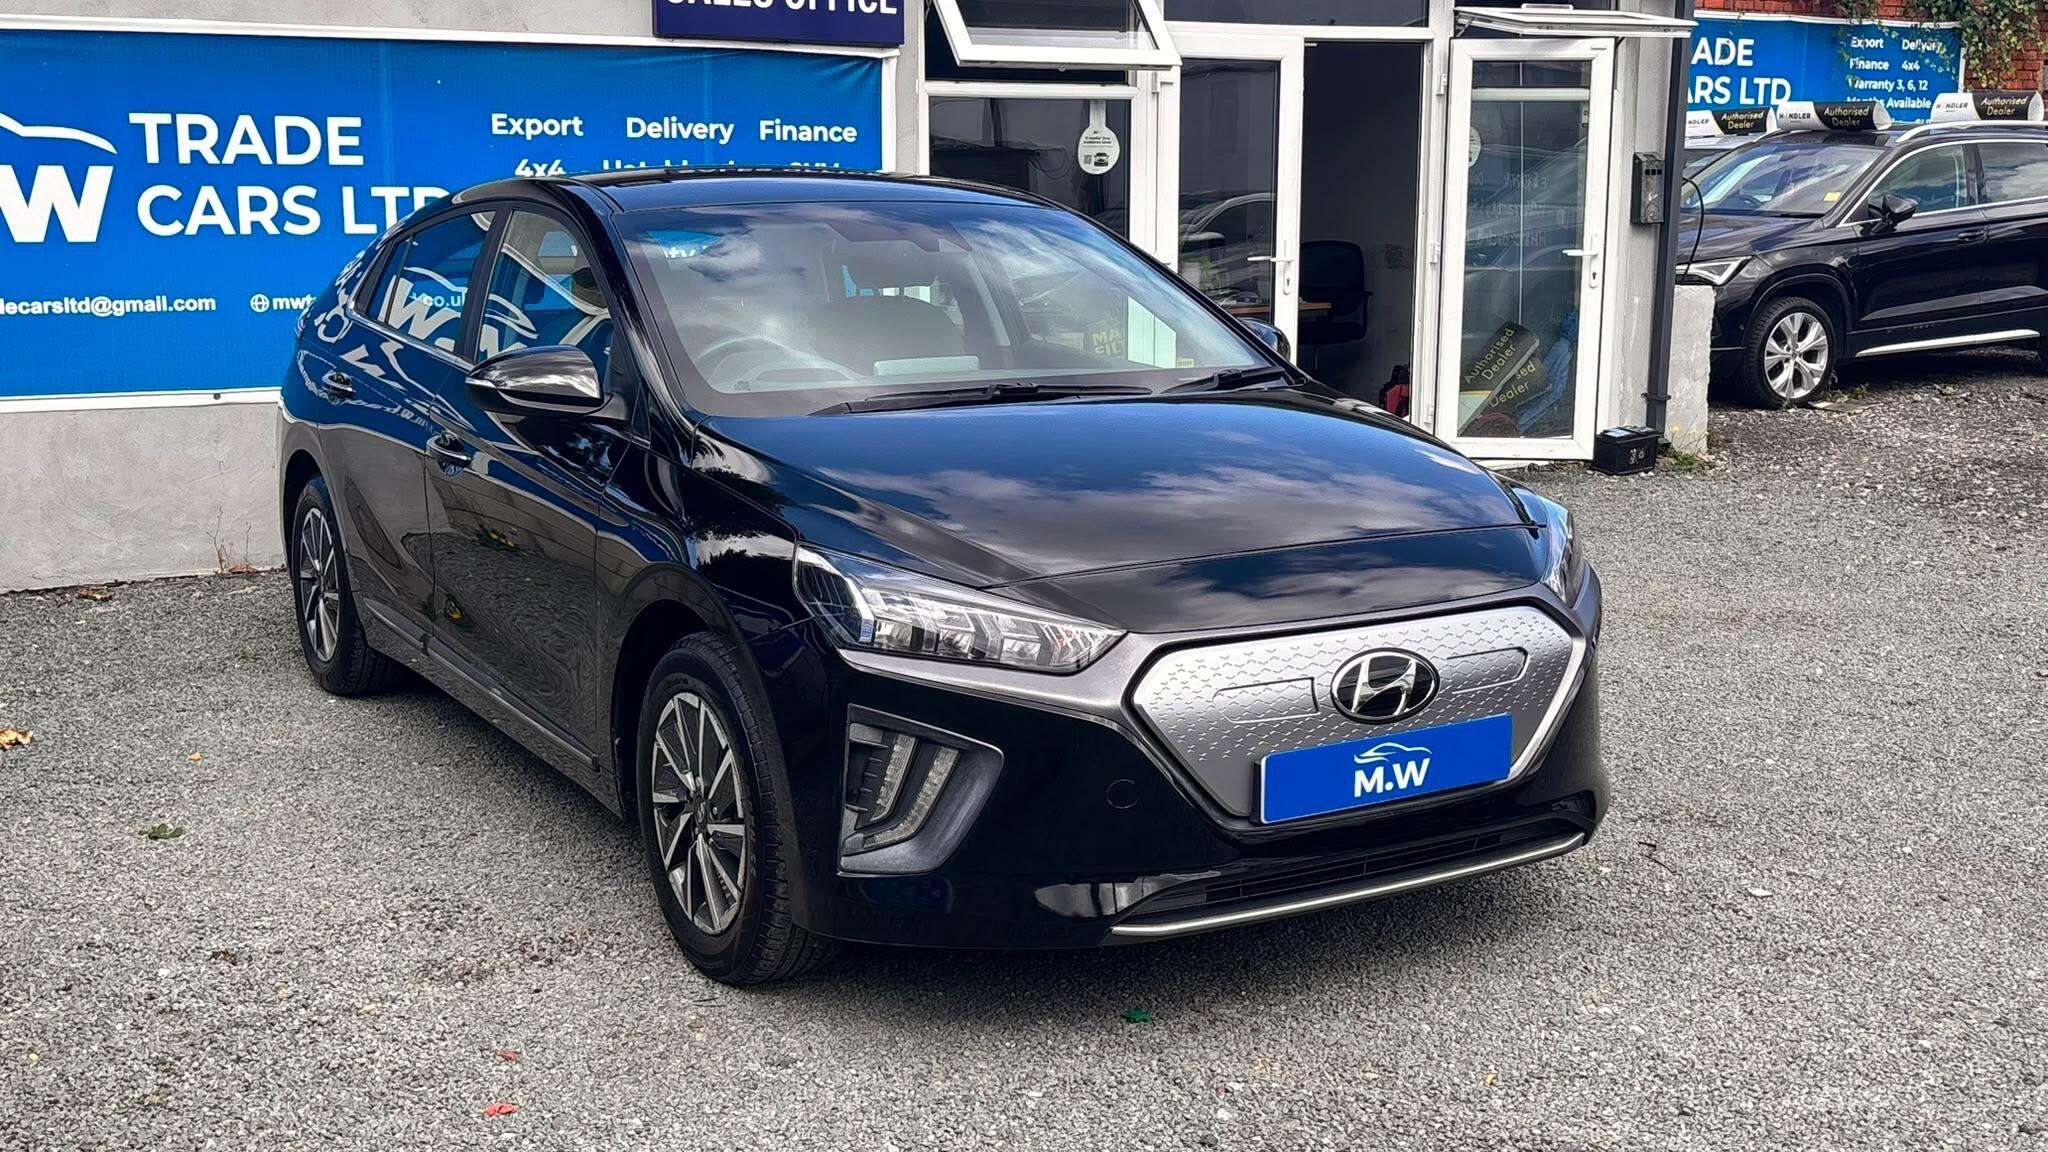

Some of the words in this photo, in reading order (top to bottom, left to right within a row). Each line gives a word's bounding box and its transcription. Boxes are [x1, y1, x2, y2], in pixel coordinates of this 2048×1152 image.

[1690, 36, 1755, 67] ADE
[1850, 36, 1884, 50] Export
[1849, 57, 1889, 71] Finance
[1901, 60, 1920, 71] 4x4
[1739, 76, 1792, 105] LTD
[1918, 79, 1928, 91] 12
[1823, 105, 1869, 117] Authorised
[1886, 96, 1931, 109] Available
[1980, 95, 2029, 106] Authorised
[1986, 105, 2016, 116] Dealer
[1721, 109, 1764, 122] Authorised
[1727, 119, 1754, 131] Dealer
[491, 113, 584, 141] Export
[626, 116, 734, 145] Delivery
[759, 119, 857, 144] Finance
[128, 112, 364, 166] TRADE
[514, 158, 566, 178] 4x4
[137, 184, 321, 236] CARS
[1463, 327, 1515, 384] Authorised
[1481, 344, 1517, 380] Dealer
[1353, 757, 1431, 798] M.W
